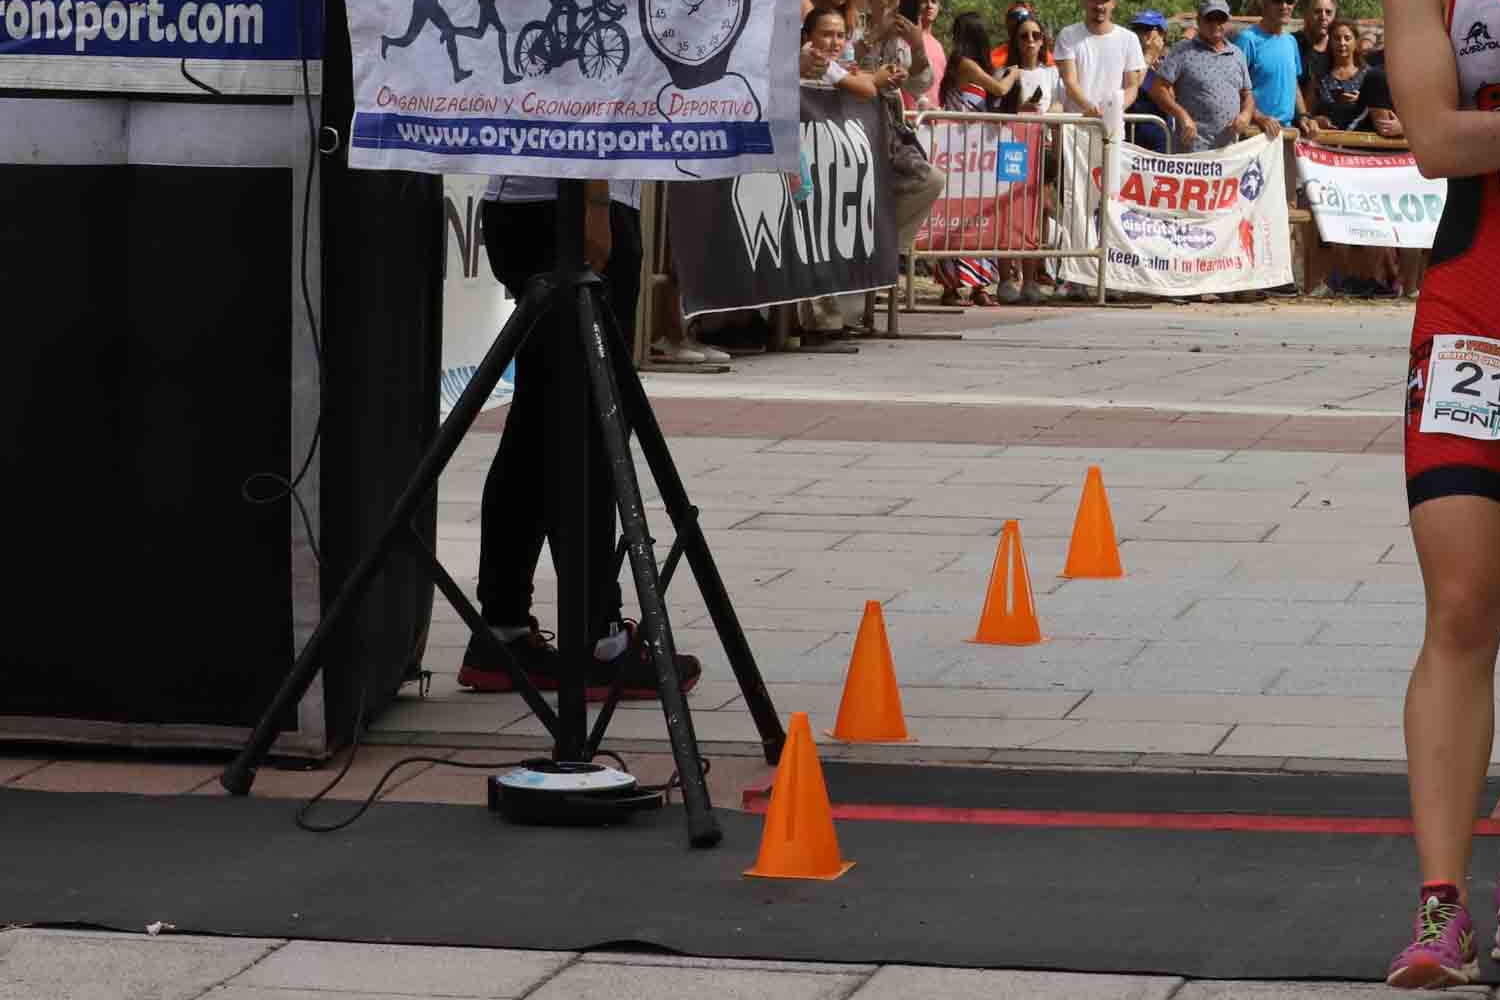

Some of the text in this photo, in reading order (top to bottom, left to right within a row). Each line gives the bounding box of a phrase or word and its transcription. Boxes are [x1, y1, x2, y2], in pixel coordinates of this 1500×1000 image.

[398, 123, 728, 158] www.orycronsport.com
[931, 142, 996, 172] lesia
[1107, 248, 1139, 266] keep
